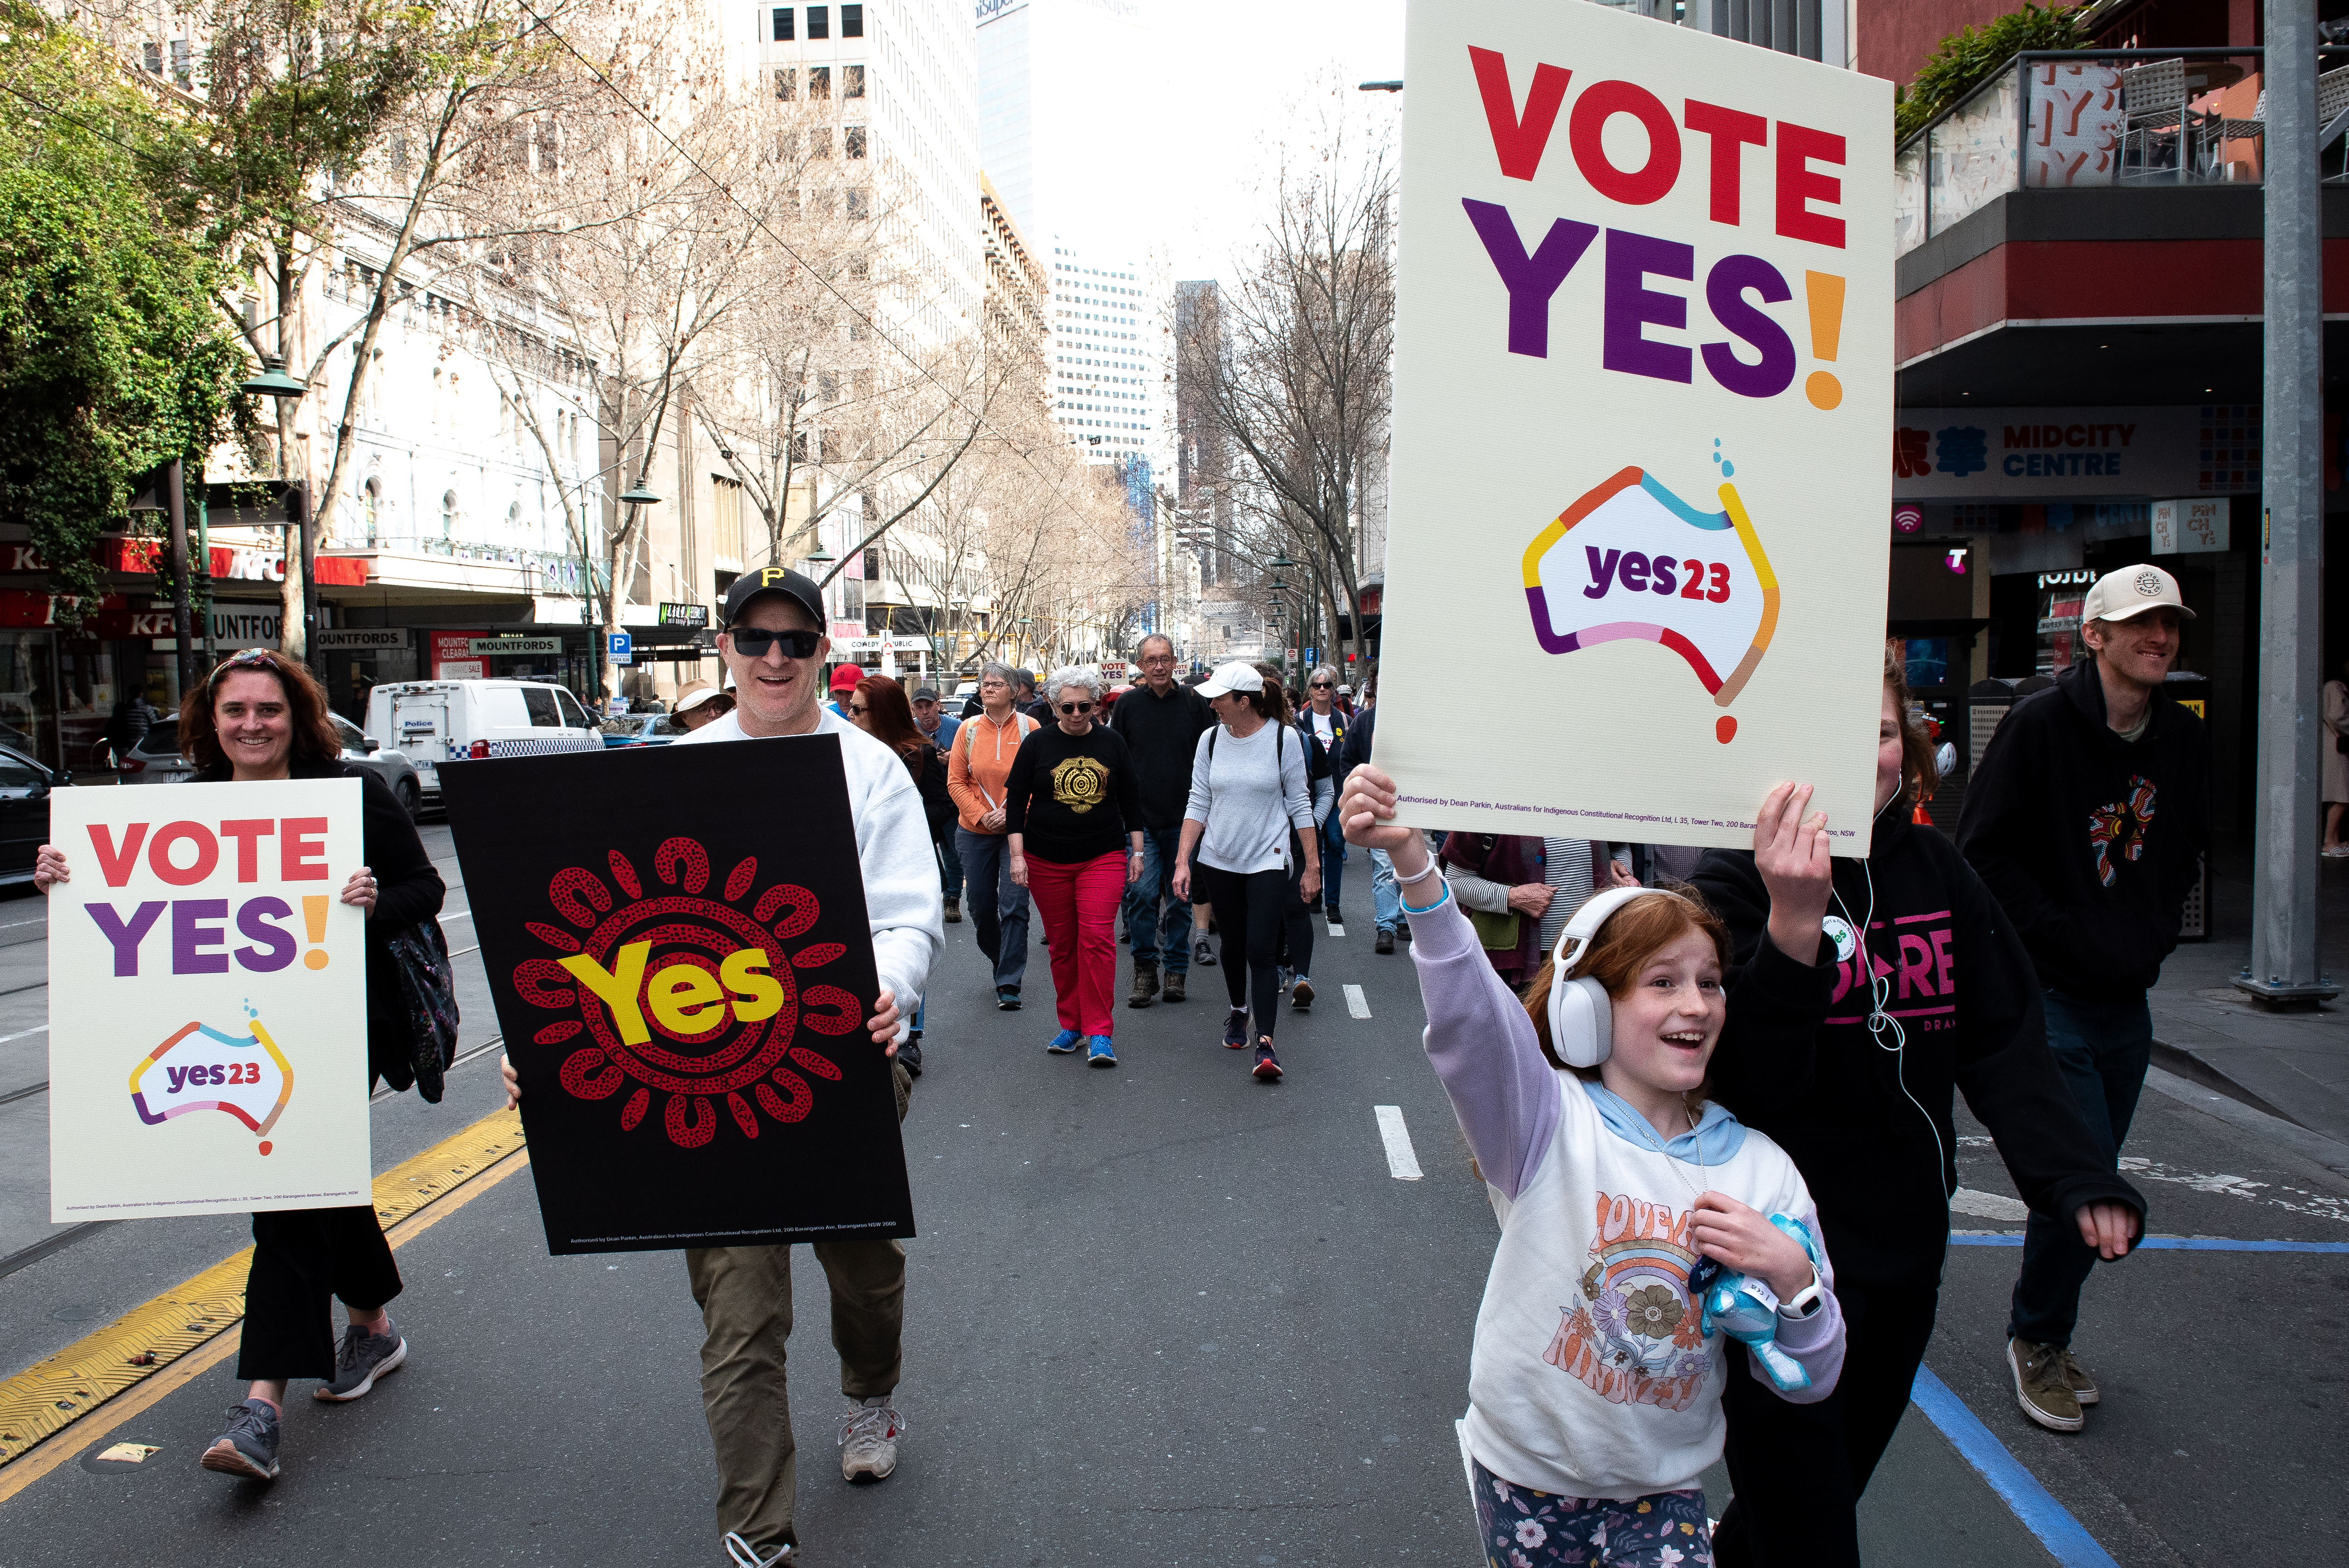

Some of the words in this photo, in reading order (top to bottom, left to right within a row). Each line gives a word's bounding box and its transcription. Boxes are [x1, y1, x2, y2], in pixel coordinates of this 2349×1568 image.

[1467, 45, 1846, 249] VOTE
[1462, 197, 1845, 410] YES!
[2003, 424, 2137, 448] MIDCITY
[2003, 453, 2121, 477] CENTRE
[1949, 549, 1967, 567] T
[761, 568, 785, 587] P
[1583, 545, 1730, 603] yes23
[129, 614, 176, 635] KF
[318, 633, 398, 644] OUNTFORDS
[477, 641, 554, 651] MOUNTFORDS
[614, 637, 625, 651] P
[1101, 670, 1126, 679] YES!
[1397, 795, 1437, 804] Authorised
[1470, 801, 1492, 809] Parkin,
[1495, 803, 1531, 812] Australians
[1544, 807, 1578, 815] Indigenous
[1580, 810, 1623, 818] Constitutional
[1625, 813, 1660, 822] Recognition
[86, 817, 329, 887] VOTE
[84, 895, 329, 977] YES!
[557, 940, 784, 1045] Yes
[167, 1062, 260, 1093] yes23
[1700, 1265, 1716, 1280] Yes
